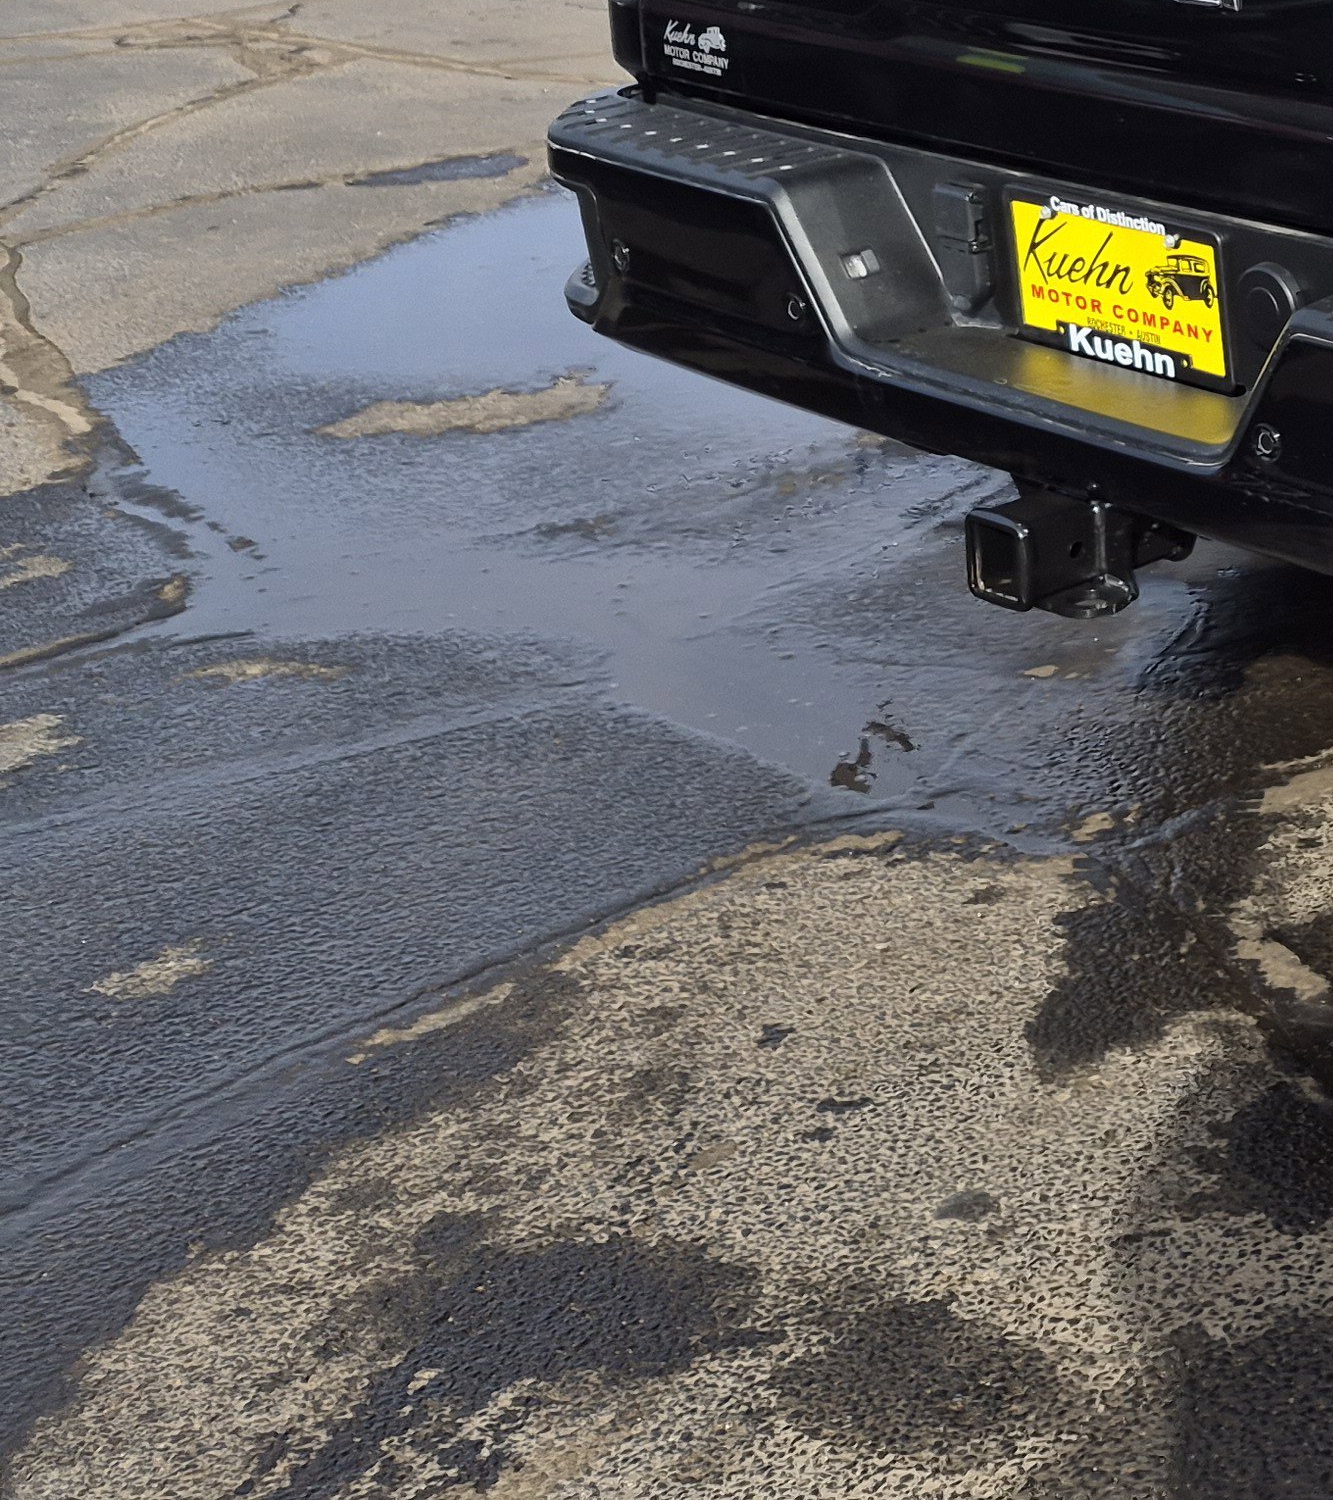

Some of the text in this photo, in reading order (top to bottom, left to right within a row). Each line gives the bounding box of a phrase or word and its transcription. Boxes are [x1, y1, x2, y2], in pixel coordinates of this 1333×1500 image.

[663, 19, 696, 46] Kuehn
[663, 43, 690, 60] MOTOR
[692, 51, 729, 70] COMPANY
[1050, 196, 1166, 236] Cars of Distinction
[1023, 218, 1134, 295] Kuehn
[1031, 284, 1213, 343] MOTOR COMPANY
[1068, 323, 1176, 378] Kuehn
